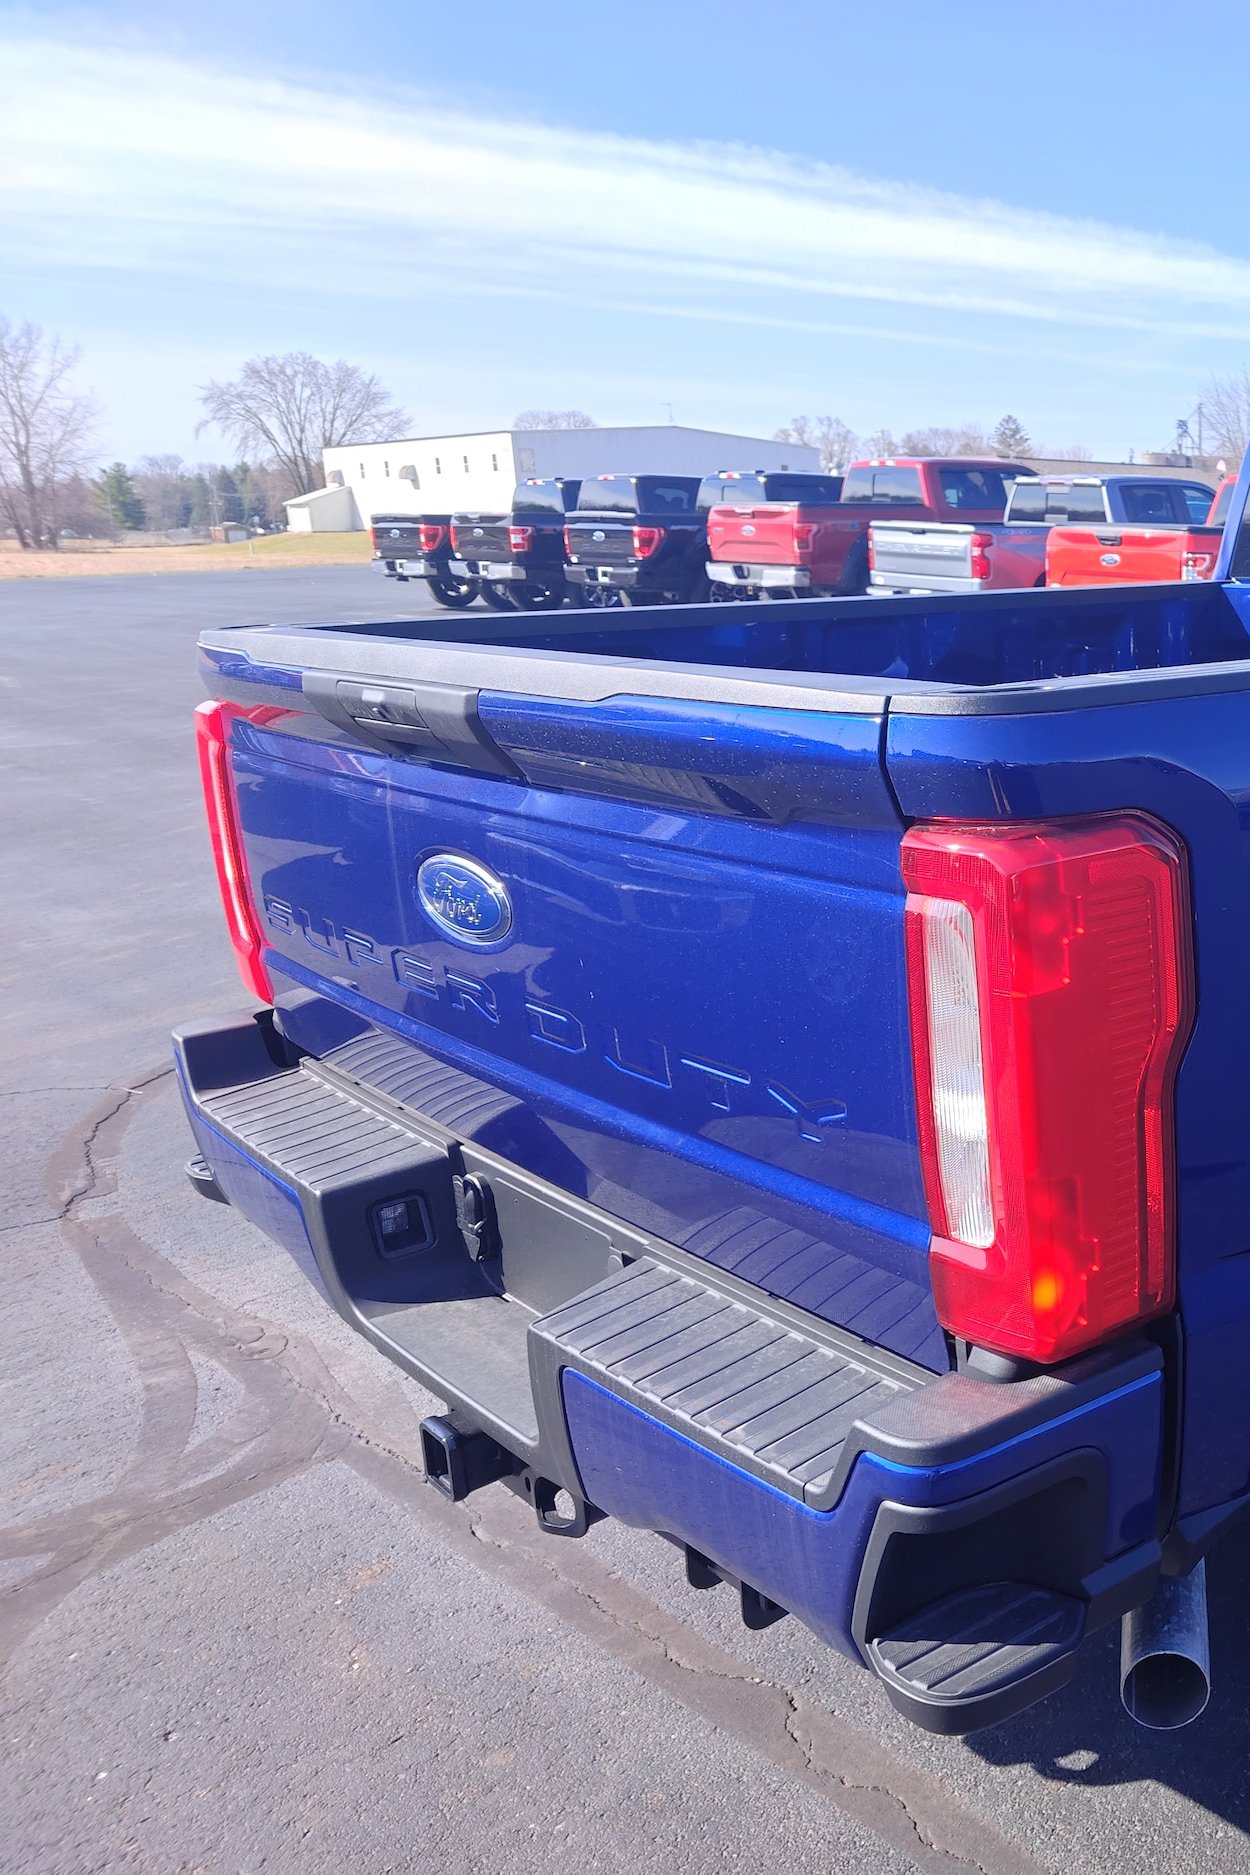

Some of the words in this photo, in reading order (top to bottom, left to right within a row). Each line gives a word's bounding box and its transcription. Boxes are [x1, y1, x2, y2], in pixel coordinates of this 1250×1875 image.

[426, 871, 482, 926] Ford
[263, 892, 500, 1025] SUPER
[523, 1001, 848, 1144] DUTY
